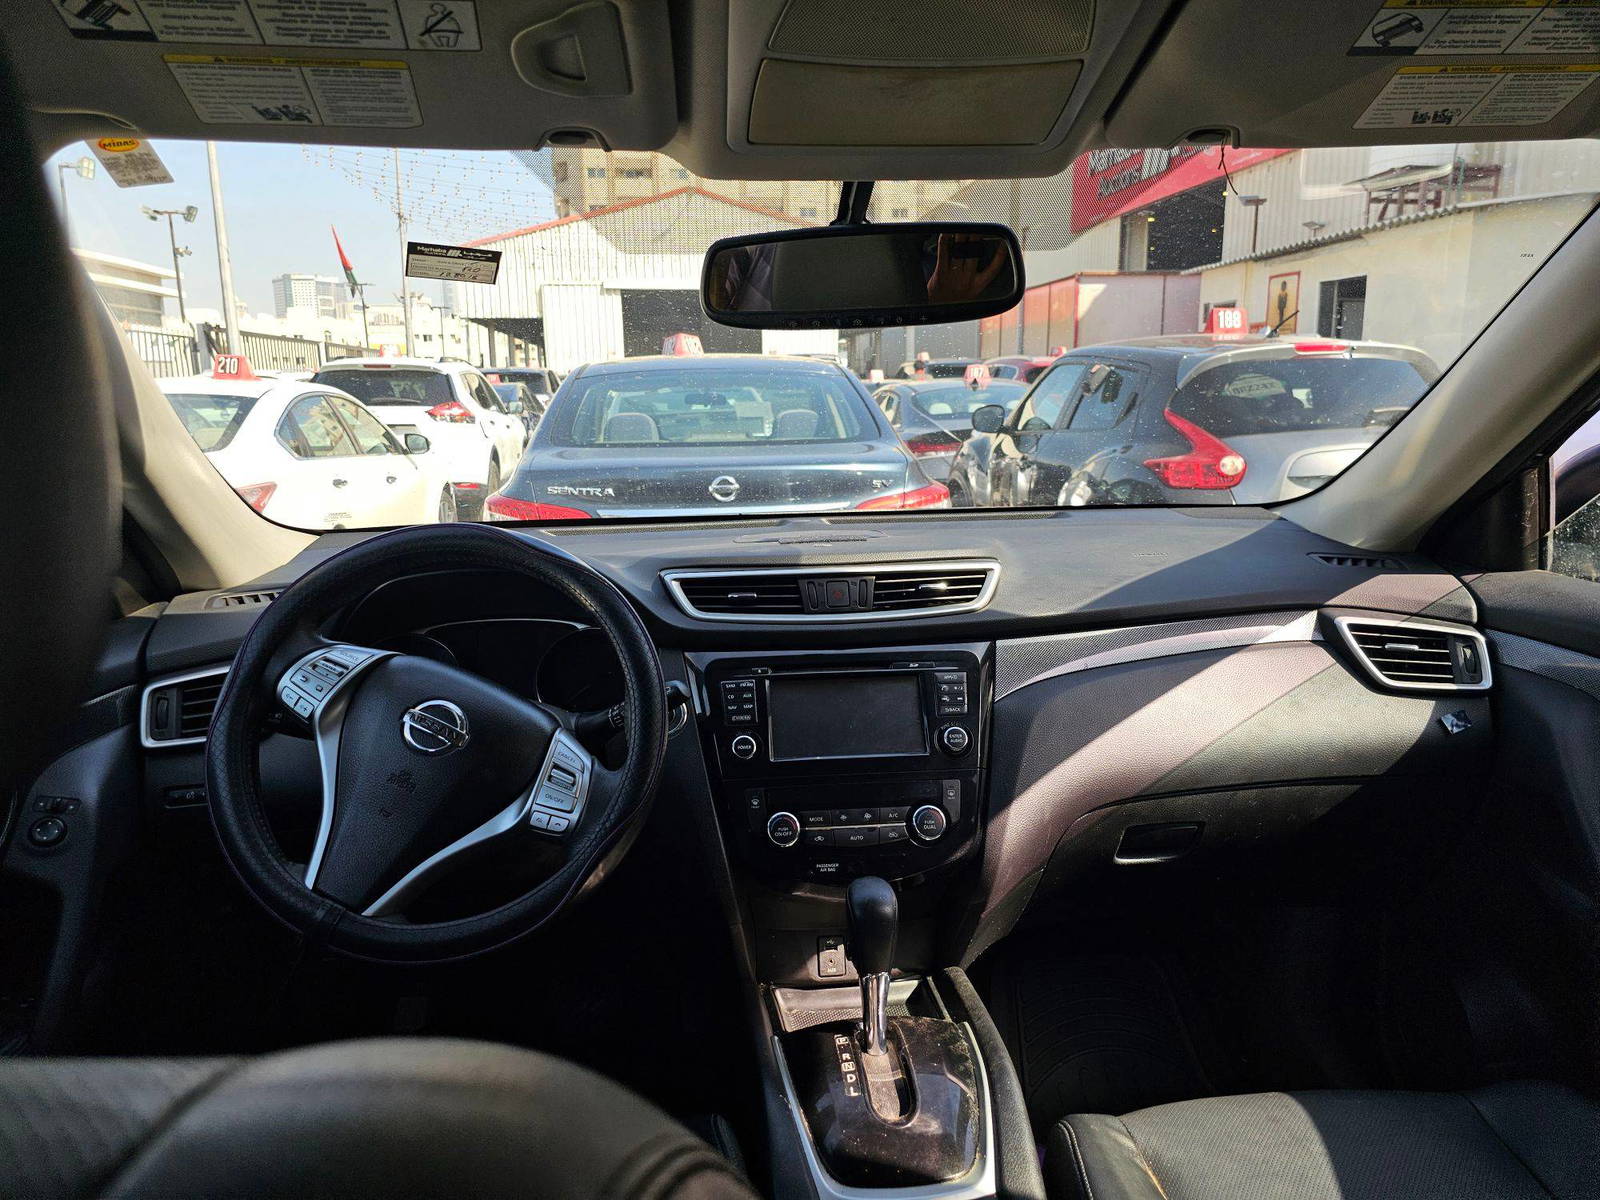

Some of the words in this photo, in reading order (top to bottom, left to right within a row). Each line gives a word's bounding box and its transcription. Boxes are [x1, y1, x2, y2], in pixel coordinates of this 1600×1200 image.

[217, 356, 239, 375] 210
[547, 486, 615, 497] SENTRA
[841, 1053, 851, 1061] R
[846, 1073, 857, 1083] D
[850, 1086, 860, 1097] L
